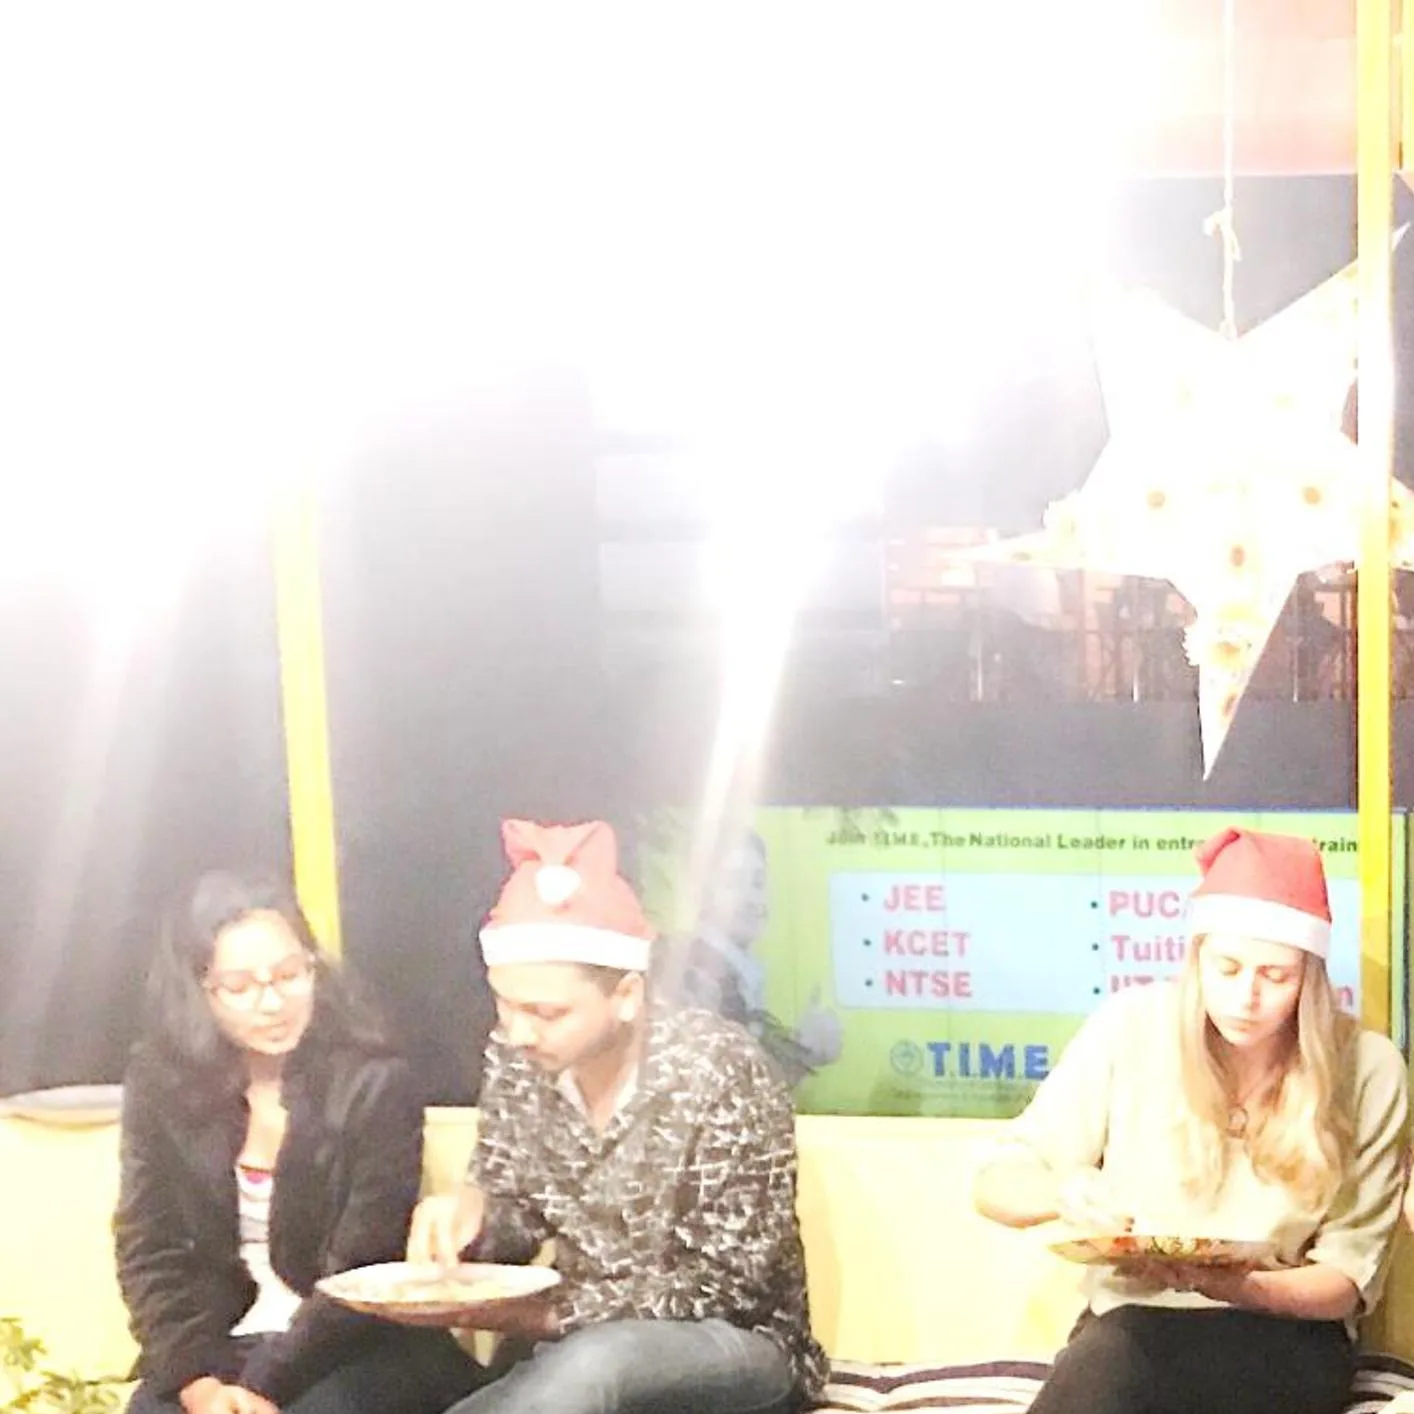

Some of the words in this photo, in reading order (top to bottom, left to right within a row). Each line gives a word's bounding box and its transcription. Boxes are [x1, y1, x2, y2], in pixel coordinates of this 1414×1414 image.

[968, 831, 1051, 849] National
[1056, 833, 1126, 850] Leader
[1132, 834, 1150, 850] in
[1156, 835, 1204, 851] entr
[1311, 838, 1359, 852] rain
[883, 884, 945, 912] JEE
[883, 929, 971, 959] KCET
[885, 969, 973, 999] NTSE
